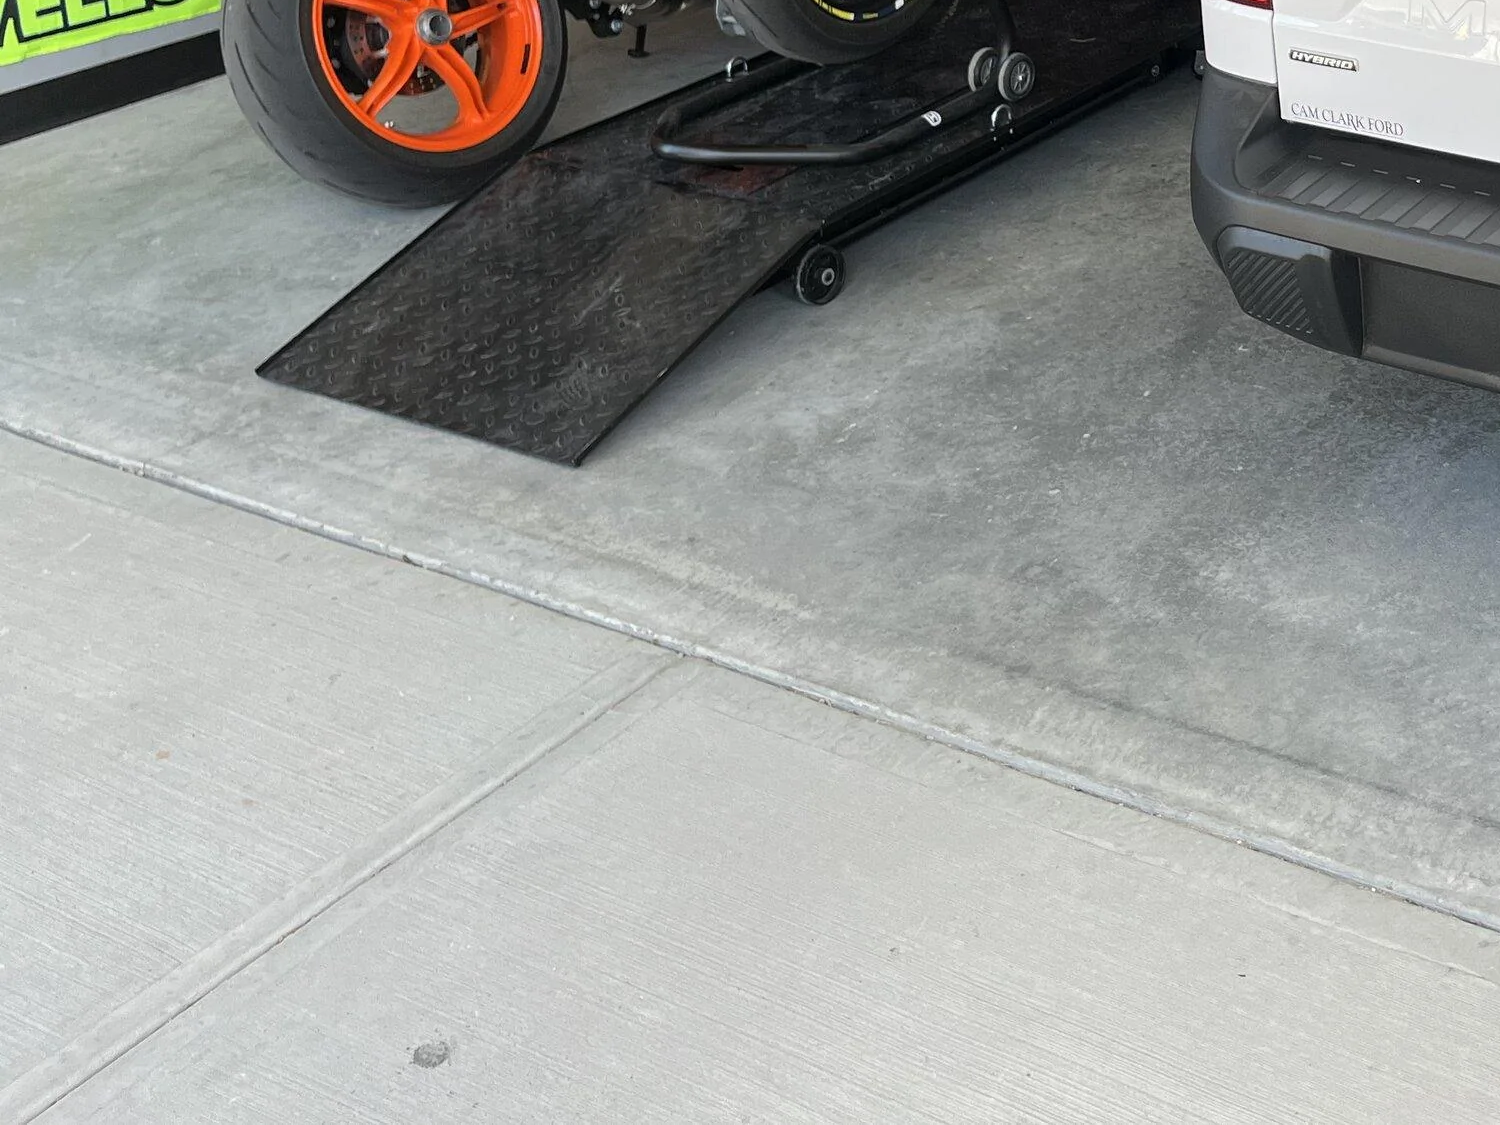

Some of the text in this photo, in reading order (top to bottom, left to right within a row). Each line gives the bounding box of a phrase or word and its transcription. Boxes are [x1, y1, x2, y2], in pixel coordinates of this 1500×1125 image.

[1291, 50, 1354, 70] HYBRID
[1291, 102, 1404, 136] CAM CLARK FORD
